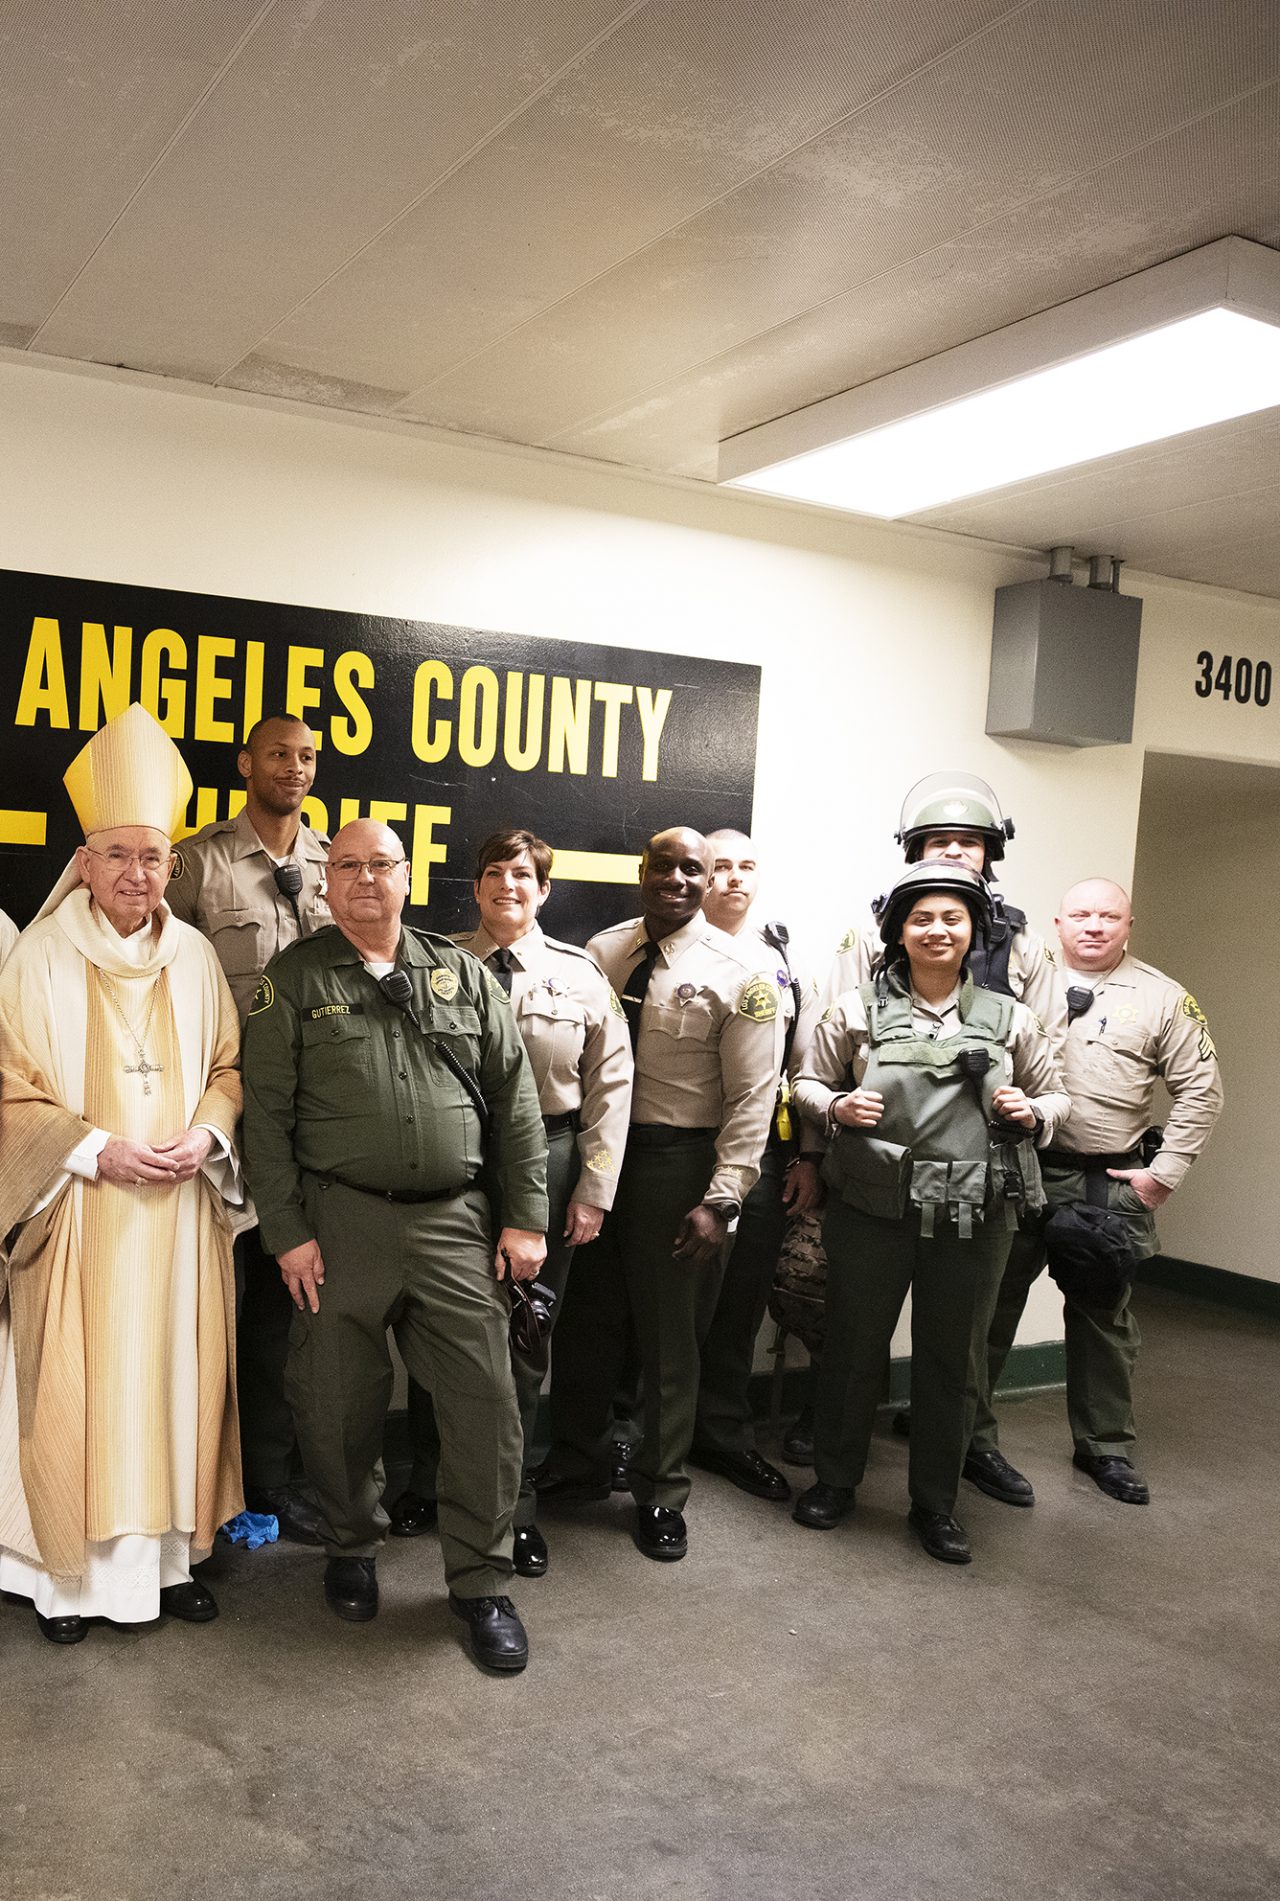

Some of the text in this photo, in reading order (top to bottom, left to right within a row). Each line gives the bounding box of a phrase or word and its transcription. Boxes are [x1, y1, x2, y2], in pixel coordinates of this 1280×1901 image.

[15, 616, 375, 756] ANGELES
[411, 659, 673, 782] COUNTY
[1195, 650, 1272, 707] 3400
[311, 1004, 351, 1019] GUTIERREZ
